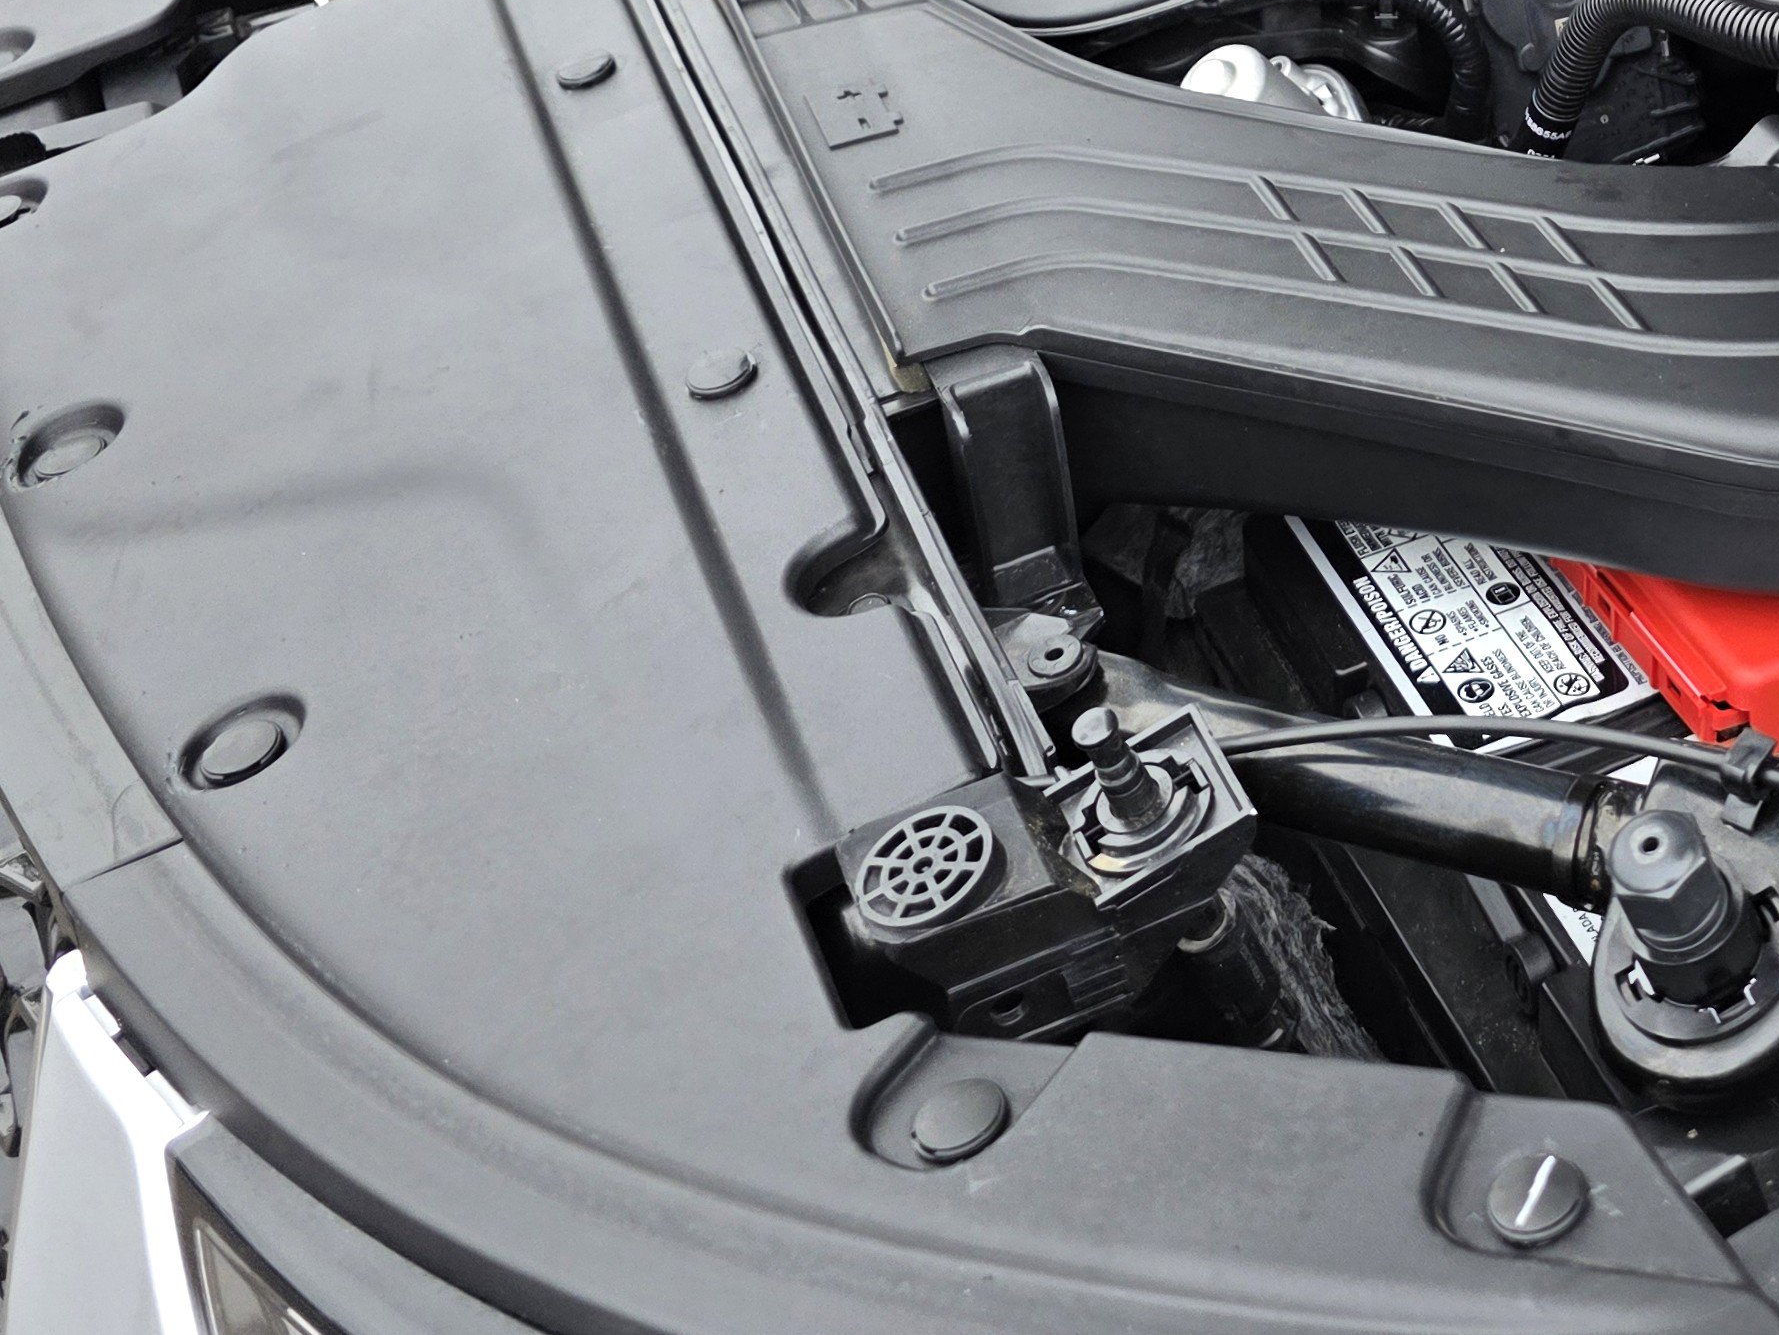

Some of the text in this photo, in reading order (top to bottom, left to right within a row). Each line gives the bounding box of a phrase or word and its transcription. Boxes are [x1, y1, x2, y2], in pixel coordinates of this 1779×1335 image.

[1353, 576, 1429, 672] DANGER/POISON
[1433, 633, 1449, 645] NO
[1479, 655, 1532, 718] EXPLOSIVE GASES
[1477, 702, 1496, 718] ELD
[1579, 913, 1599, 942] LADA
